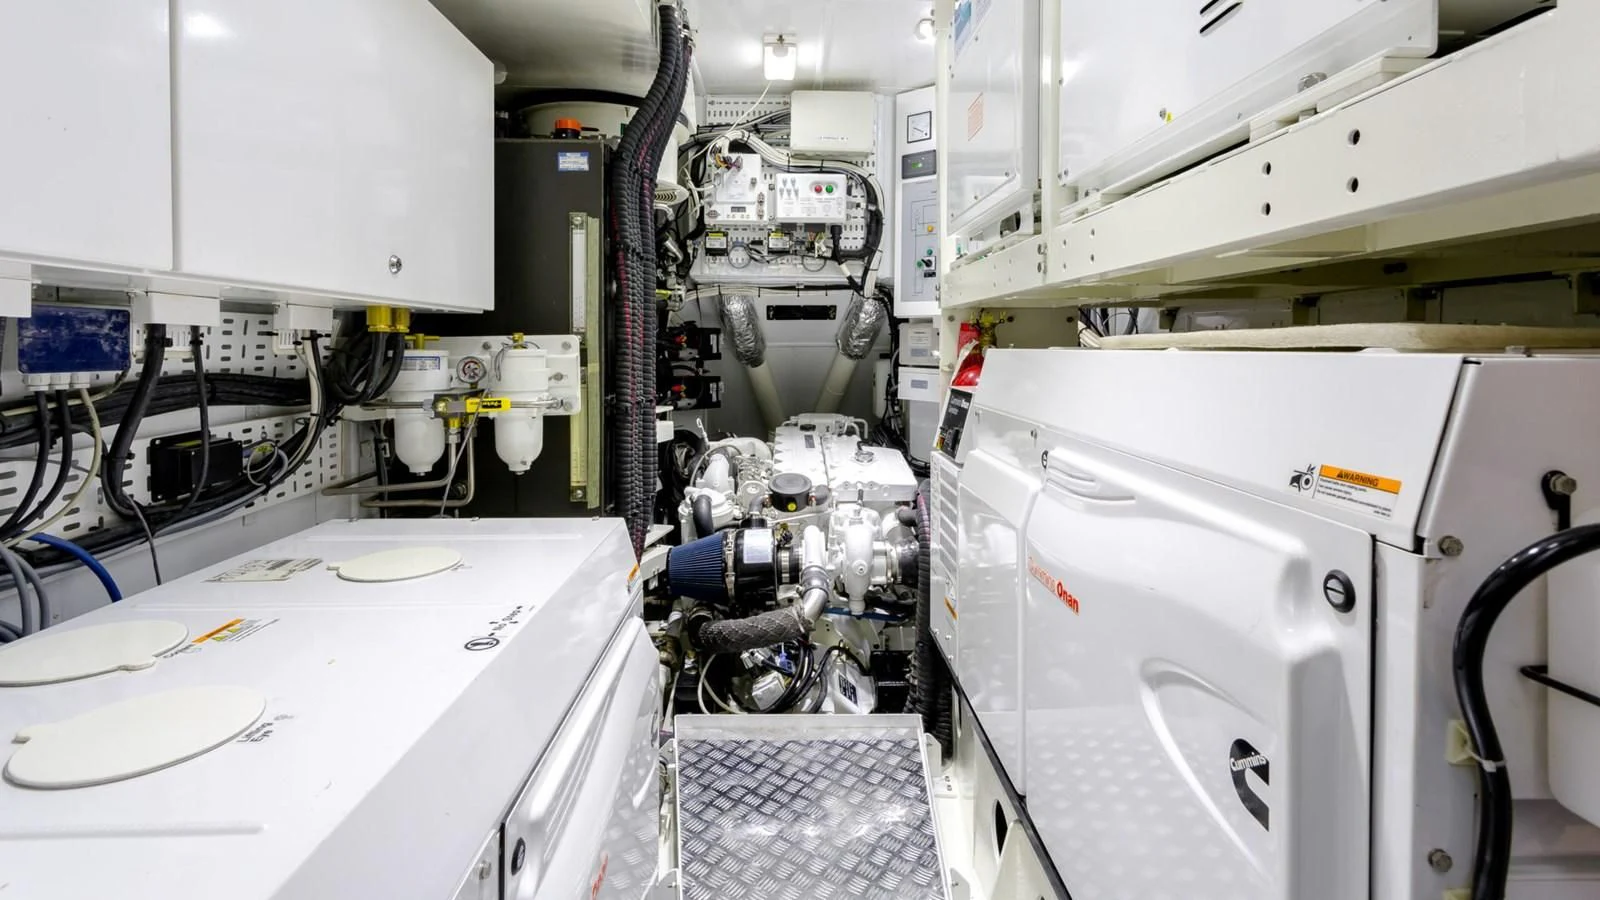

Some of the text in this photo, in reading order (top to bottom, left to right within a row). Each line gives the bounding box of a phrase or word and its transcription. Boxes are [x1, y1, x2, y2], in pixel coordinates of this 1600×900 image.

[1343, 471, 1380, 487] WARNING
[1056, 581, 1079, 613] Onan
[1230, 755, 1267, 771] Cummins
